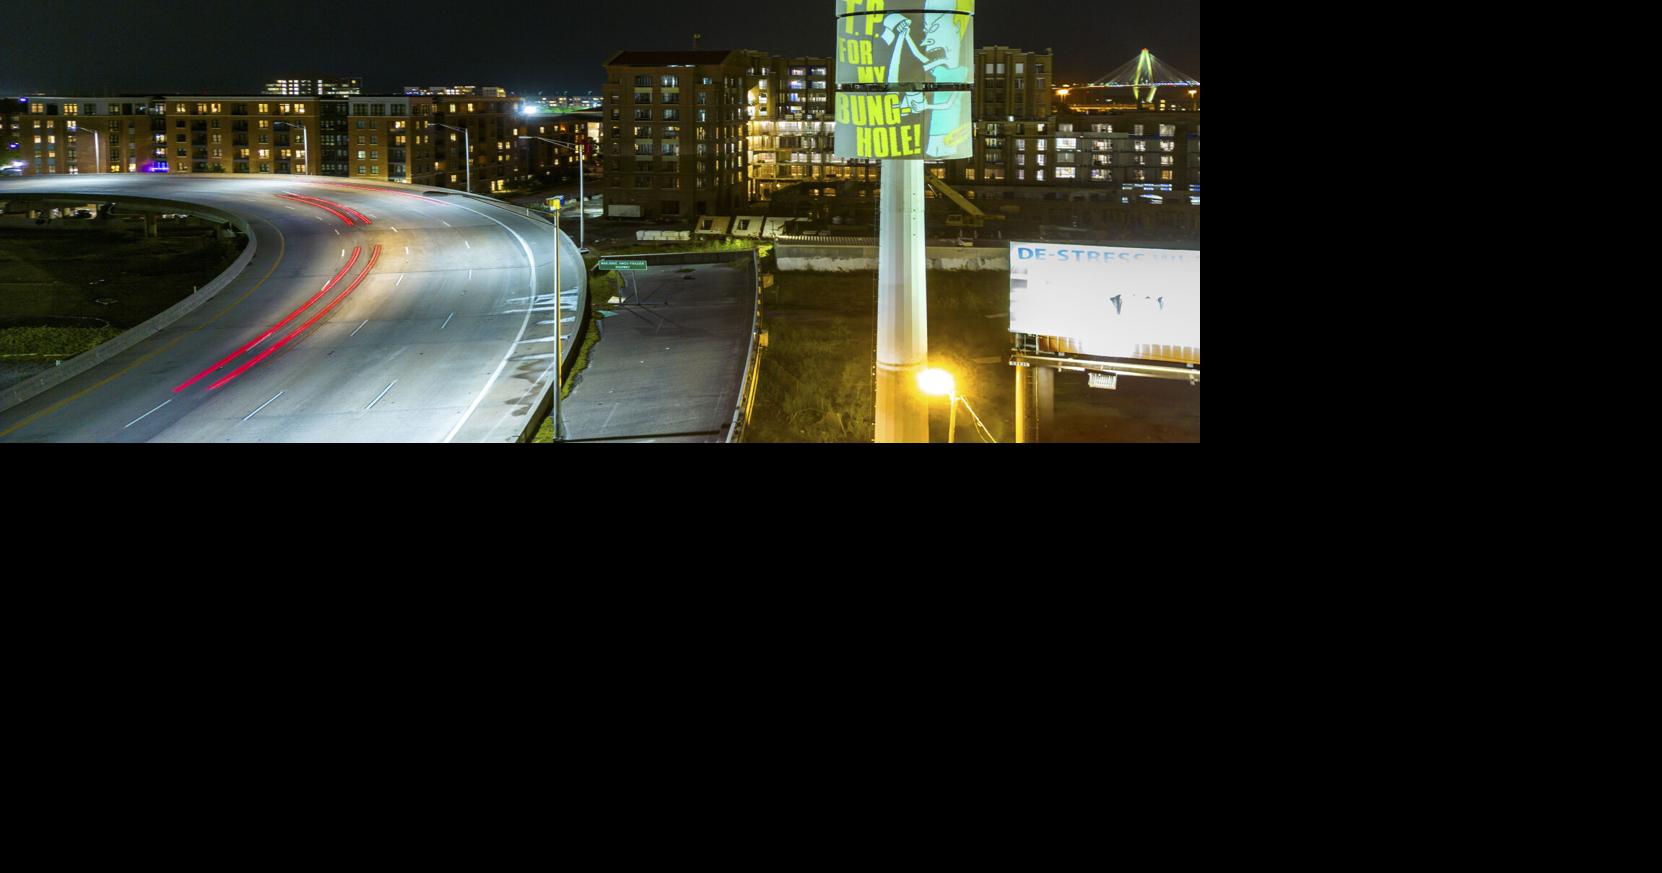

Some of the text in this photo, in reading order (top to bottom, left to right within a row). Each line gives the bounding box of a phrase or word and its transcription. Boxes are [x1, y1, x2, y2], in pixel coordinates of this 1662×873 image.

[844, 0, 884, 38] T.P.
[839, 37, 873, 65] FOR
[857, 65, 886, 83] MY
[835, 91, 911, 126] BUNG-
[856, 123, 922, 158] HOLE!
